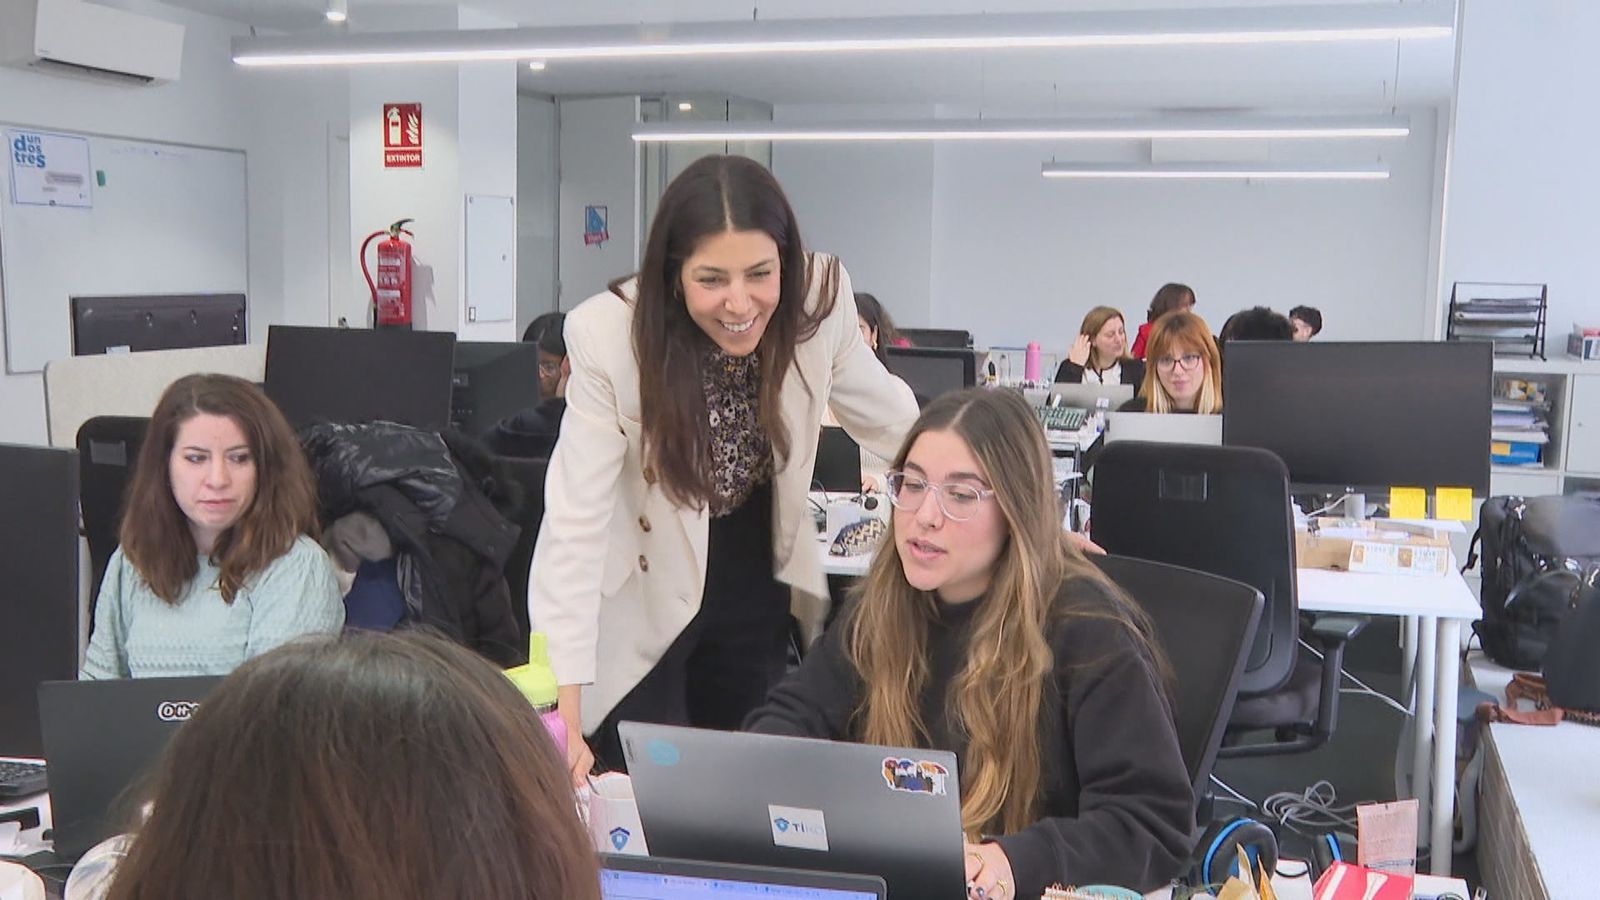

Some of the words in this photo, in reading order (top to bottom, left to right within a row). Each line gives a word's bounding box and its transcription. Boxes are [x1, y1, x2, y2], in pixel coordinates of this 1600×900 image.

[14, 135, 42, 153] dos
[27, 135, 41, 143] un
[15, 150, 46, 168] tres
[386, 154, 420, 163] EXTINTOR
